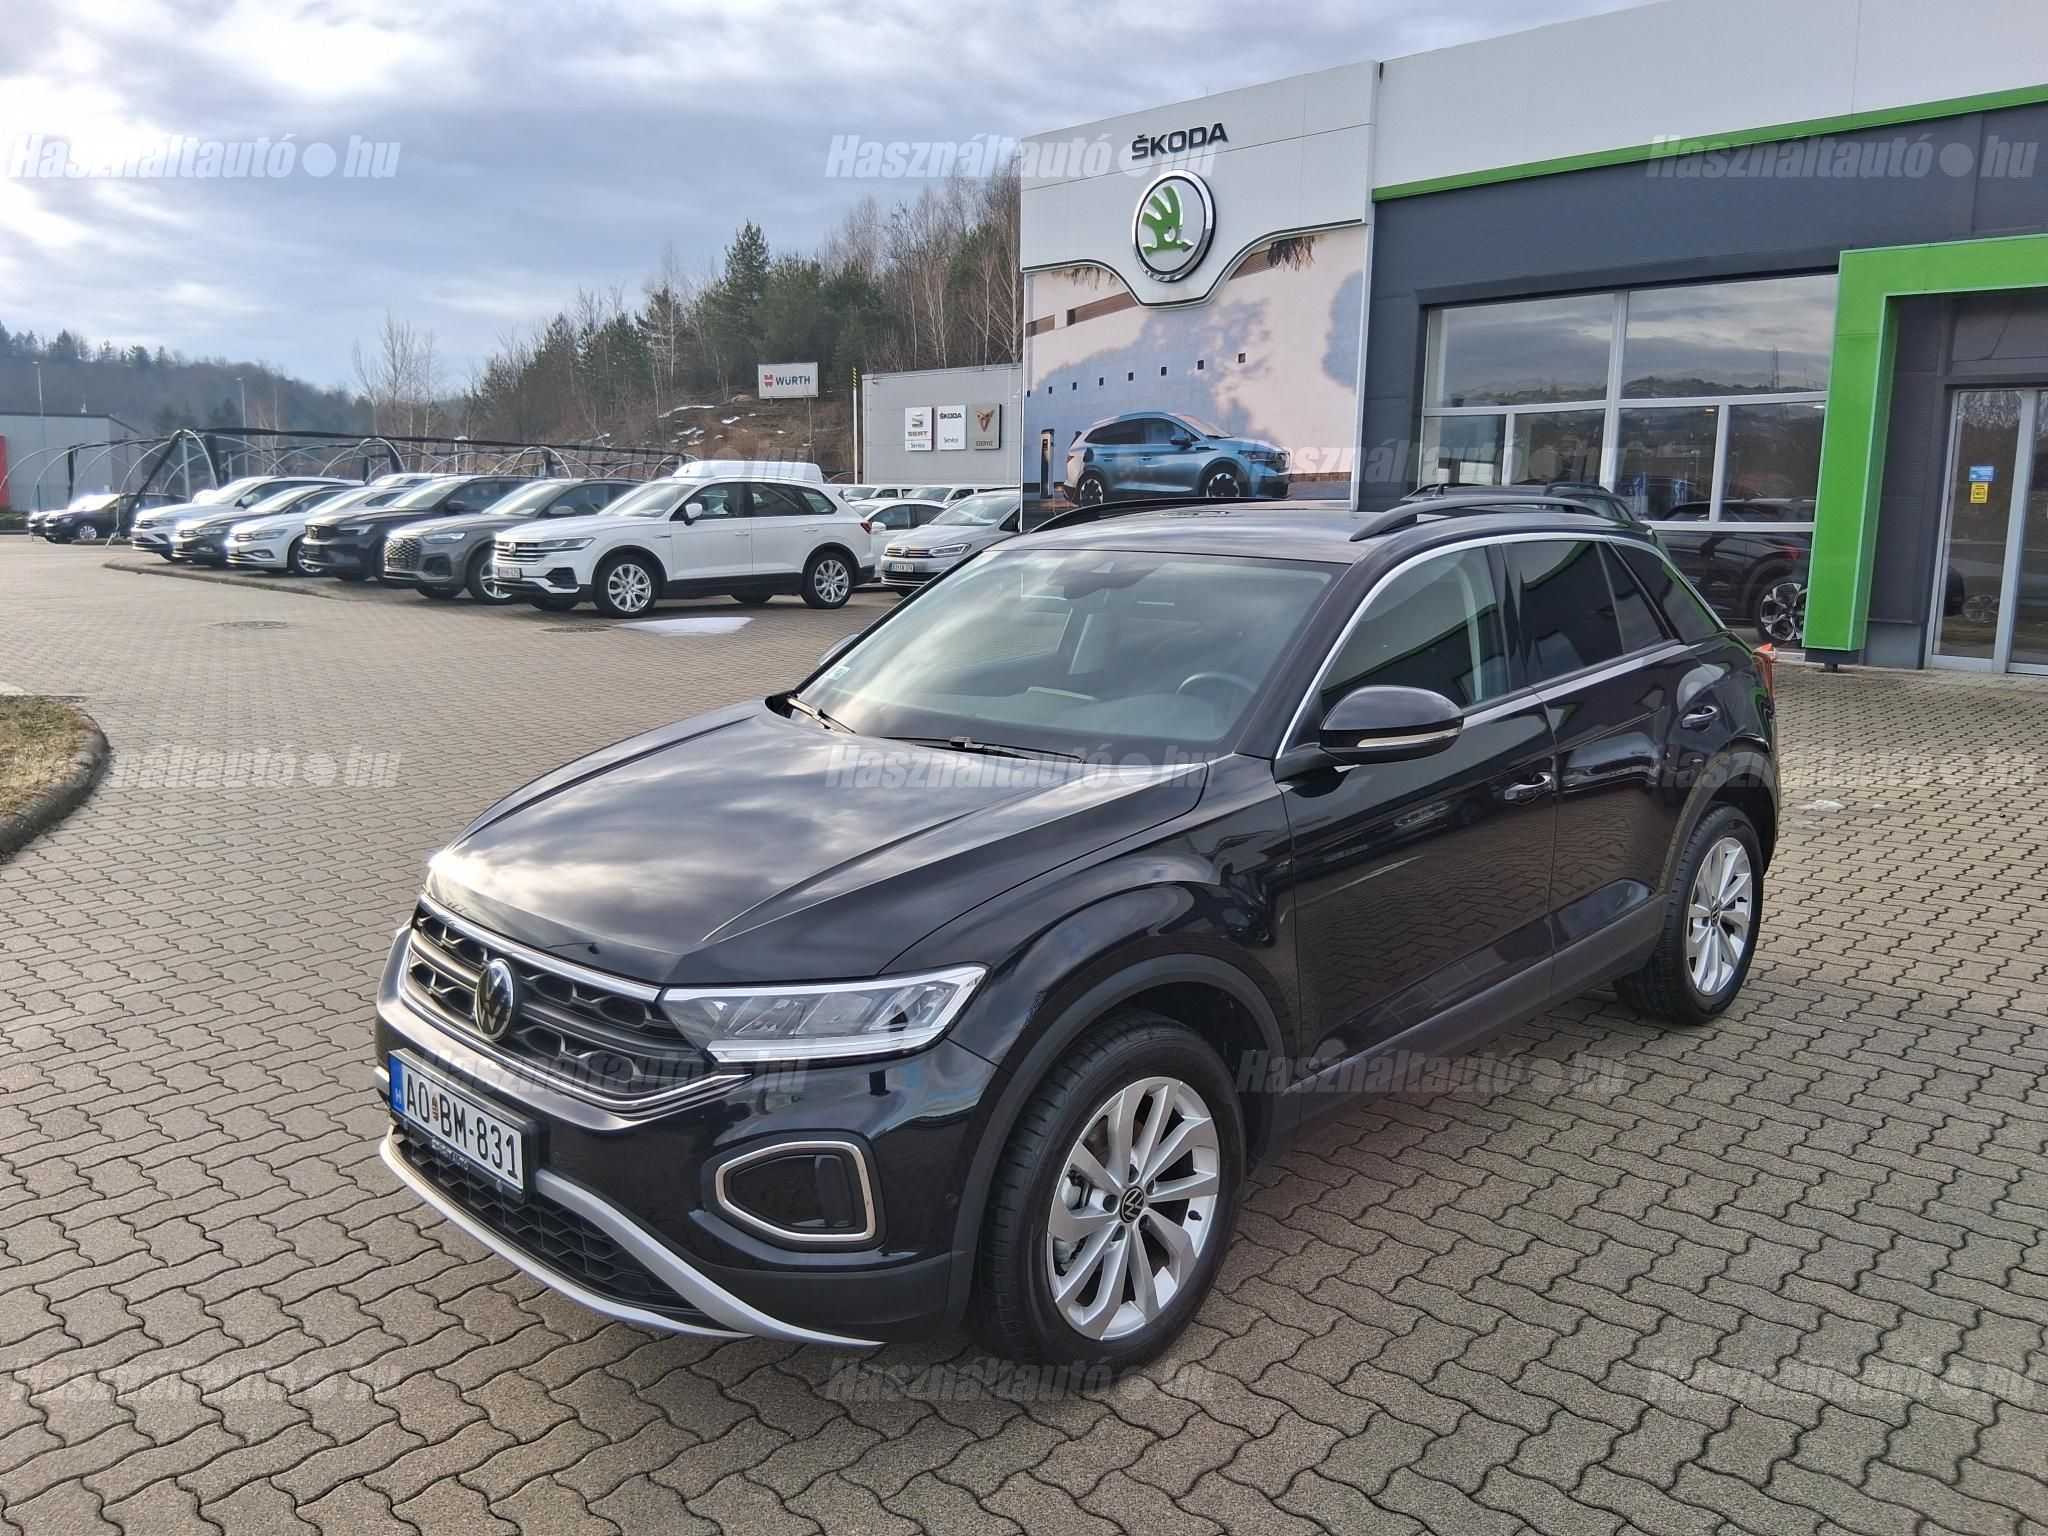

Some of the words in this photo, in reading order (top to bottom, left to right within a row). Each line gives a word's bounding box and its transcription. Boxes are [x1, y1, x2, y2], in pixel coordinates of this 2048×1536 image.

[1131, 122, 1229, 160] ŠKODA
[775, 375, 811, 386] WÜRTH
[939, 412, 962, 420] ŠKODA
[942, 436, 959, 444] Service
[439, 1093, 519, 1180] BM-831
